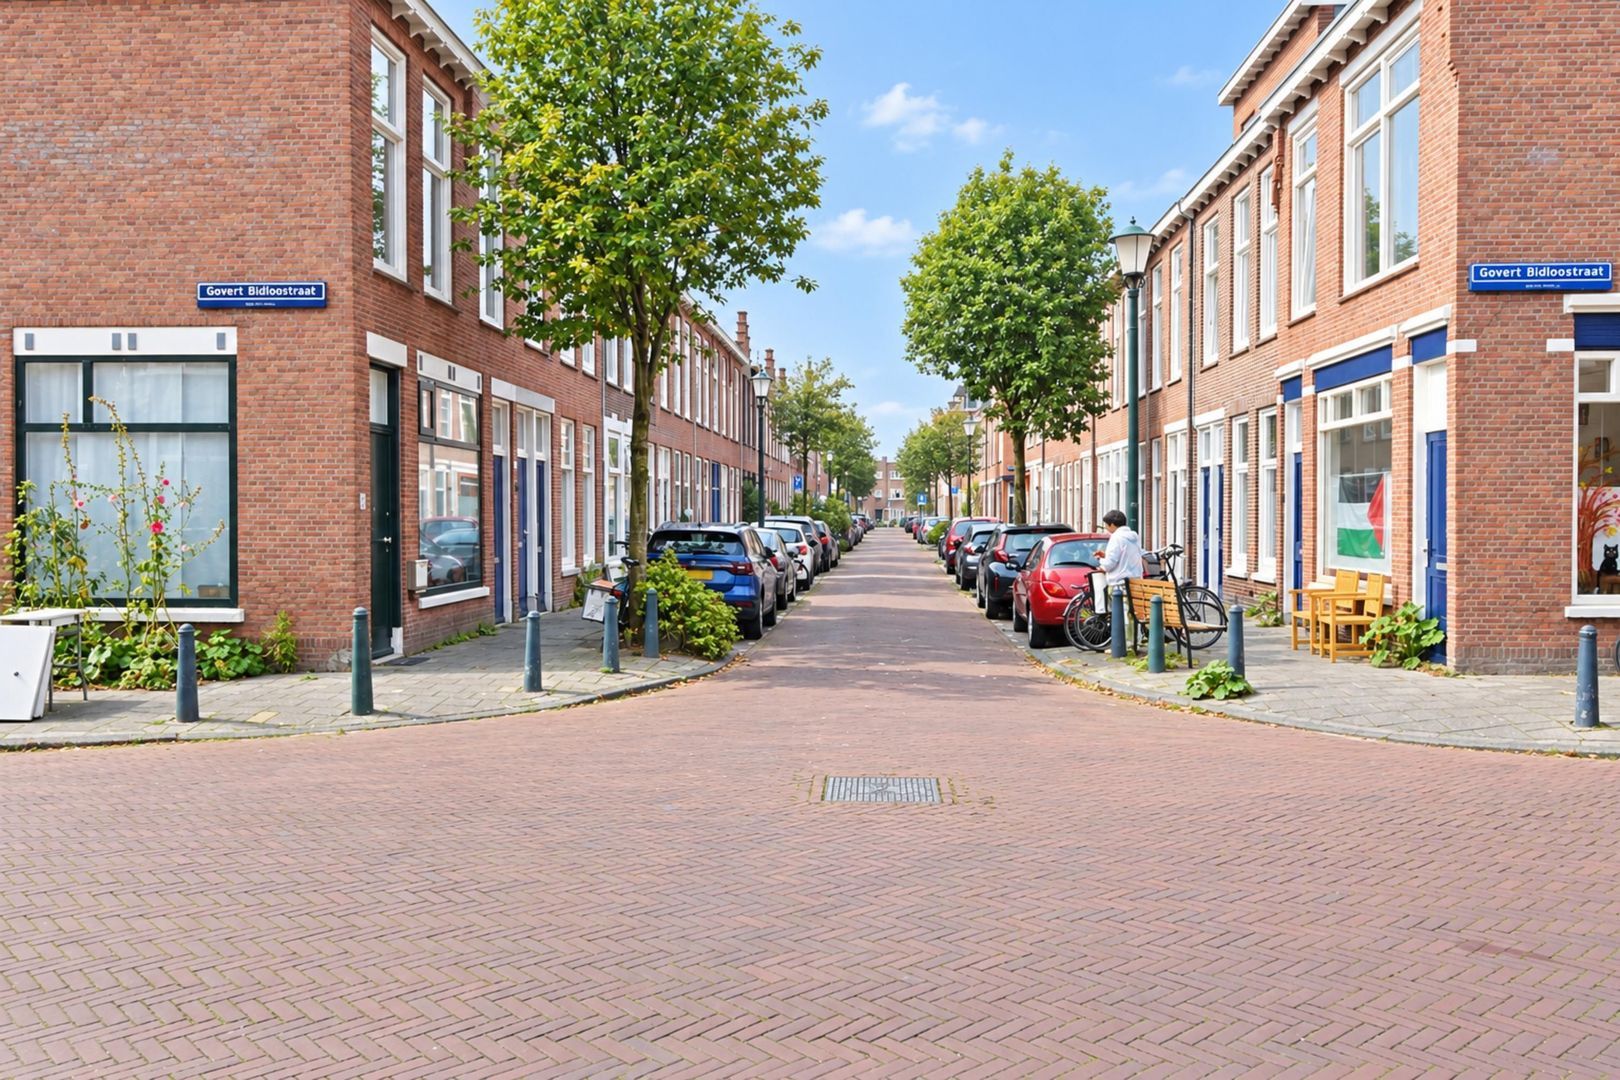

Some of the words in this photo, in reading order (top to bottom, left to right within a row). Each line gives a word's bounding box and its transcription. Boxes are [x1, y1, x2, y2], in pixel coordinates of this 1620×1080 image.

[1479, 267, 1522, 278] Govert
[1527, 266, 1604, 277] Bidloostraat
[206, 286, 244, 296] Govert
[248, 285, 316, 296] Bidloostraat
